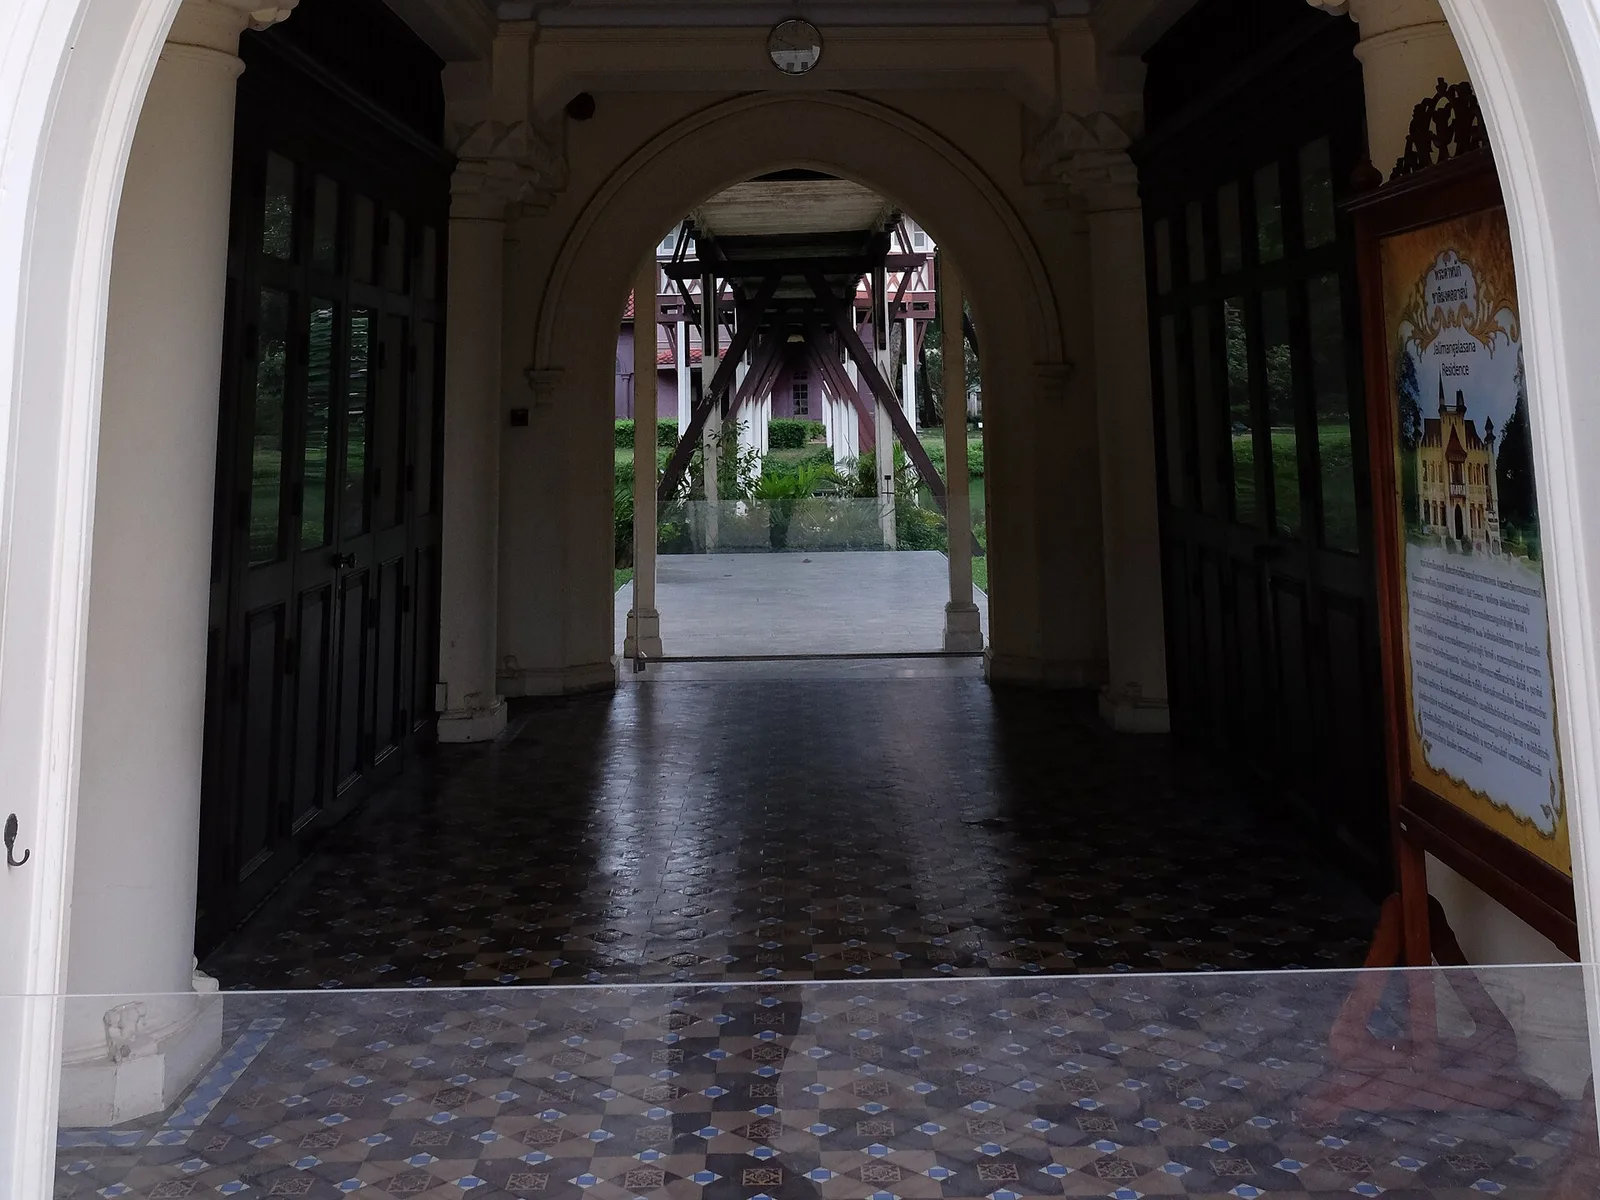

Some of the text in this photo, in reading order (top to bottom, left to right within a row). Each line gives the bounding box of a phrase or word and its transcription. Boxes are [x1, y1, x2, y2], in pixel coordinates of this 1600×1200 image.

[1434, 260, 1462, 281] พระตำหนัก
[1433, 341, 1476, 357] Jalimangalasana
[1441, 362, 1469, 377] Residence
